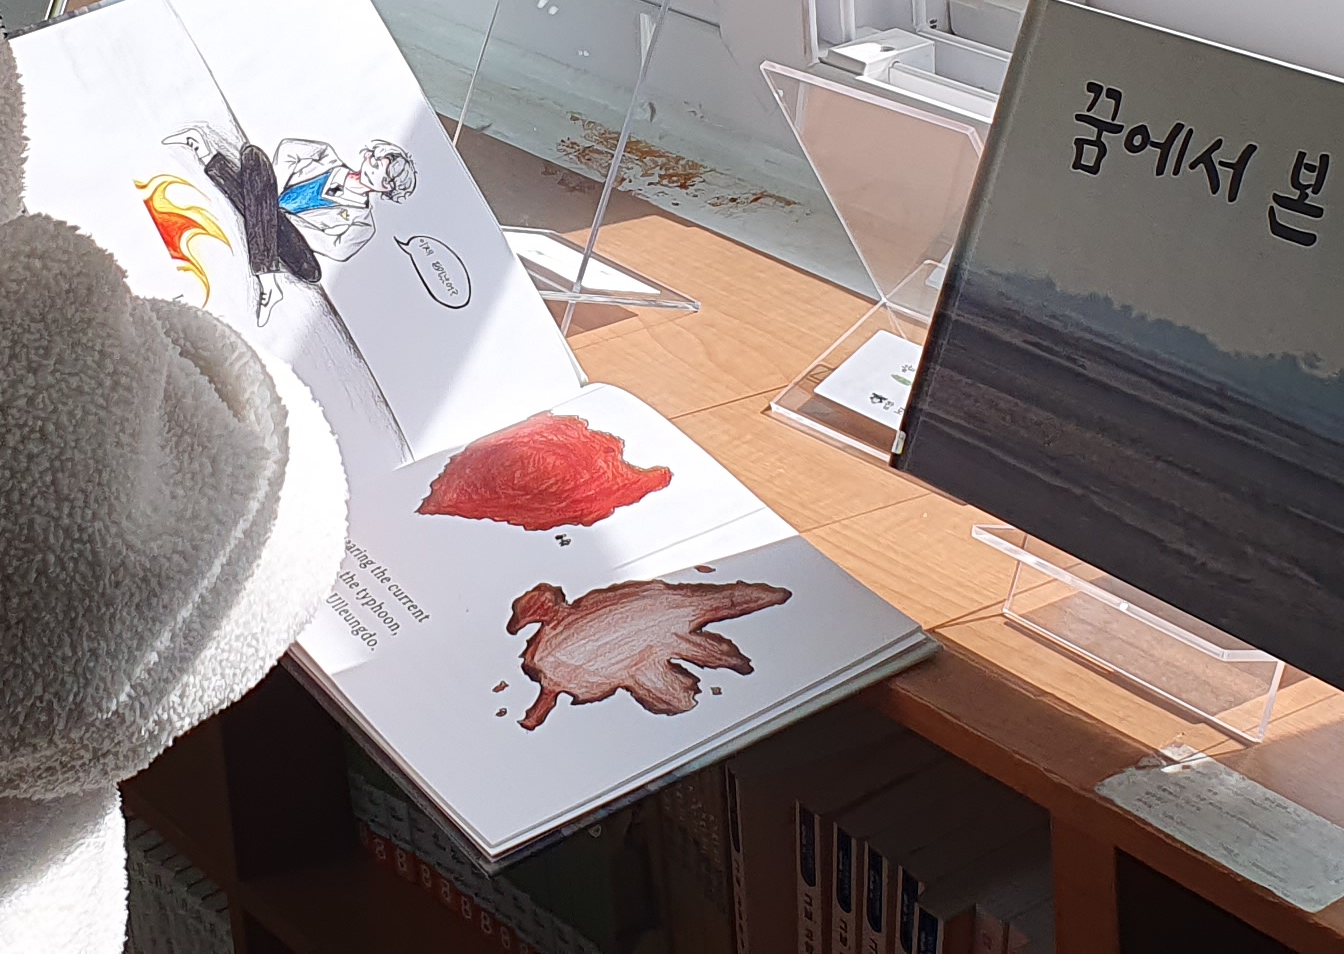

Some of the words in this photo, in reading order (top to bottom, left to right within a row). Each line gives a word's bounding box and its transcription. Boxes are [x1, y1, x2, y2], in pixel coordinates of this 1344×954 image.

[1071, 80, 1258, 204] 꿈에서
[1267, 150, 1331, 247] 본
[326, 592, 378, 651] Ulleungdo.
[339, 571, 360, 589] the
[356, 587, 400, 636] typhoon,
[370, 566, 391, 584] the
[388, 583, 430, 623] current
